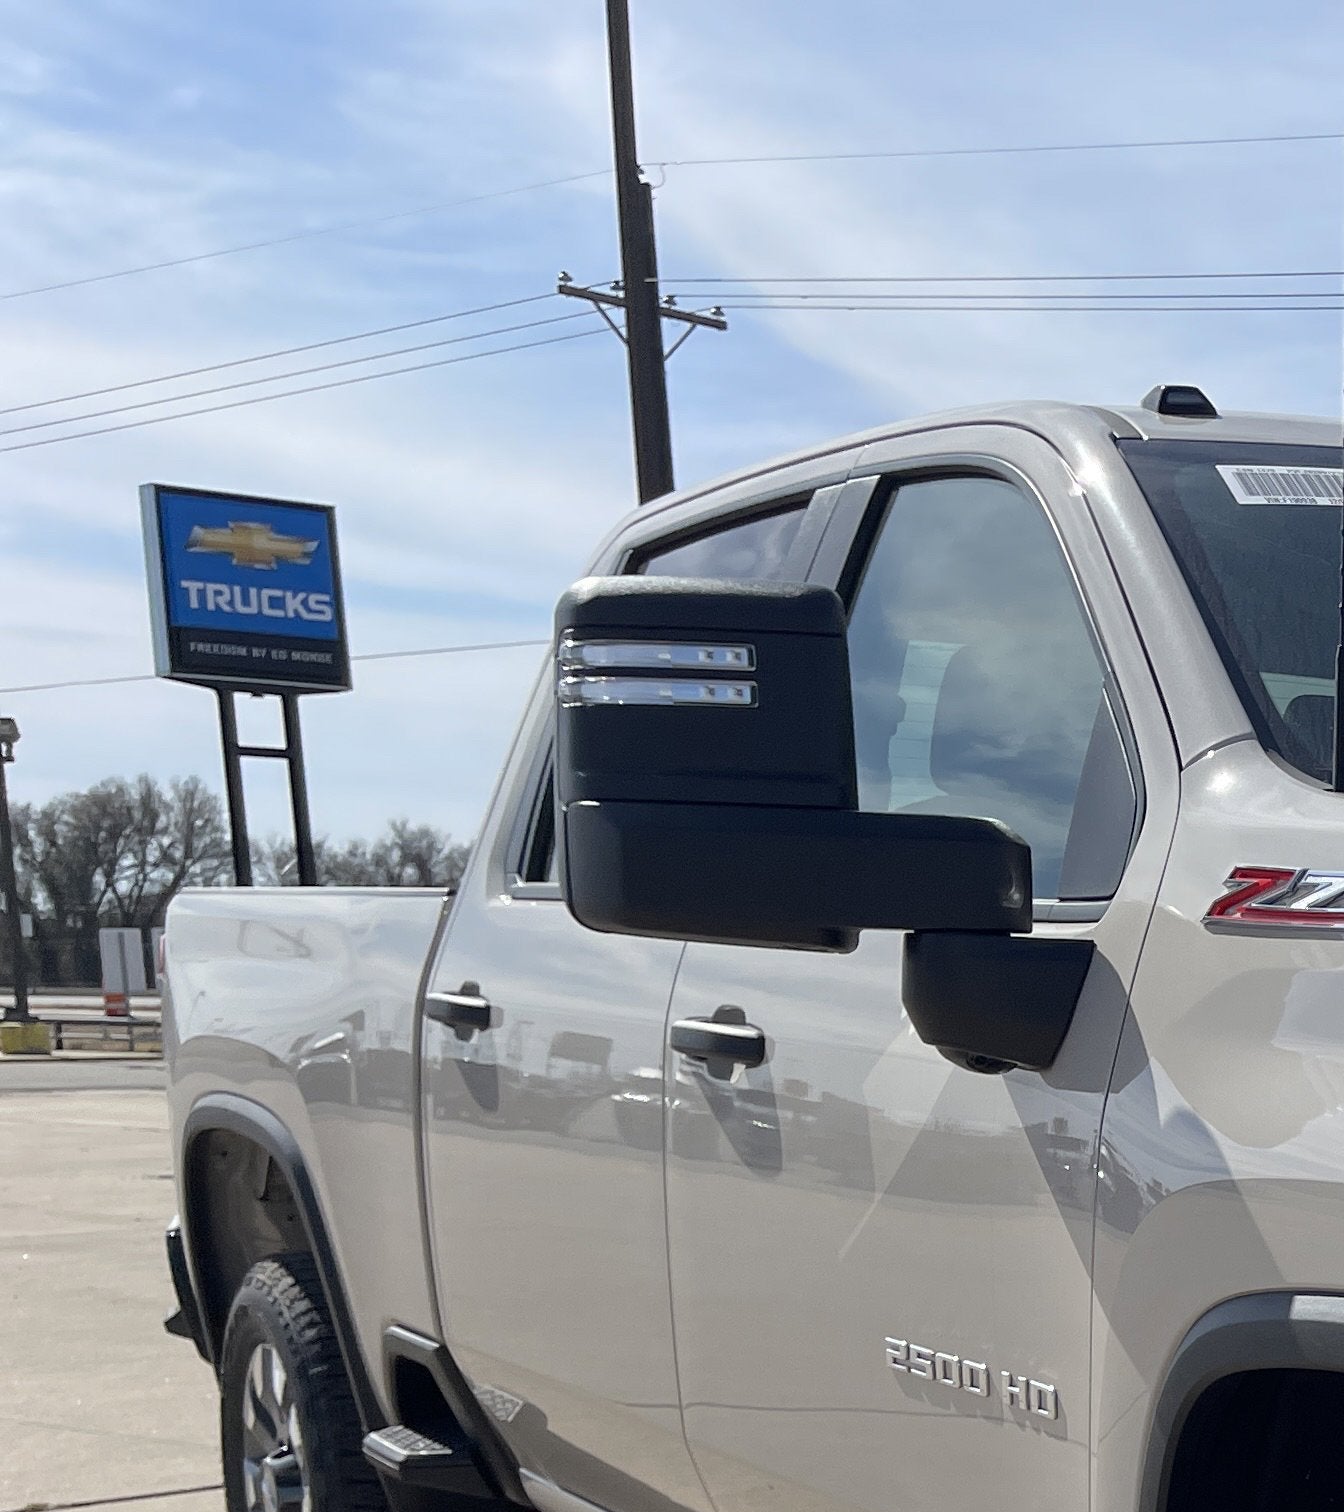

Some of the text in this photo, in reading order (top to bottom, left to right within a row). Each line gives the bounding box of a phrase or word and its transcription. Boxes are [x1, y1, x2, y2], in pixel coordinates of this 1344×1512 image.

[181, 579, 334, 623] TRUCKS
[884, 1336, 1059, 1421] 2500 HD
